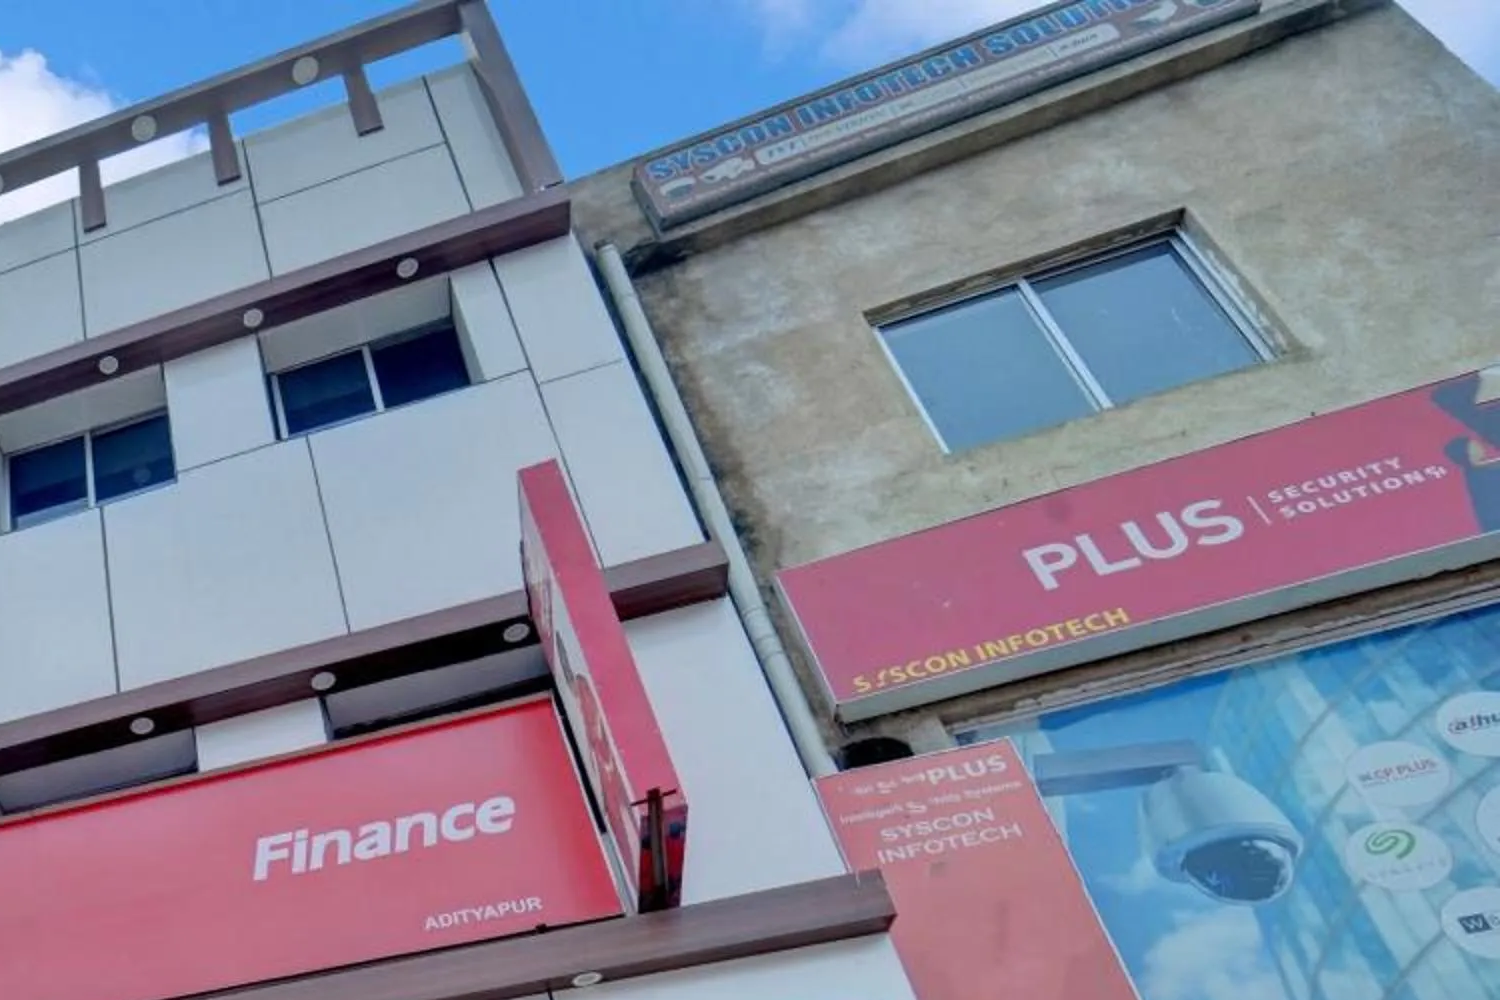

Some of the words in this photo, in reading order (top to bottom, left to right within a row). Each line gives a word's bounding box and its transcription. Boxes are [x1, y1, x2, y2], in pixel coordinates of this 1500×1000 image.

[645, 114, 793, 181] SYSCON
[797, 46, 980, 128] INFOTECH
[1267, 456, 1402, 505] SECURITY
[1278, 464, 1447, 520] SOLUTIONS
[1022, 498, 1244, 591] PLUS
[974, 607, 1130, 662] INFOTECH
[926, 754, 1008, 786] PLUS
[252, 795, 515, 881] Finance
[876, 822, 1022, 865] INFOTECH
[879, 806, 995, 843] SYSCON
[422, 895, 543, 932] ADITYAPUR
